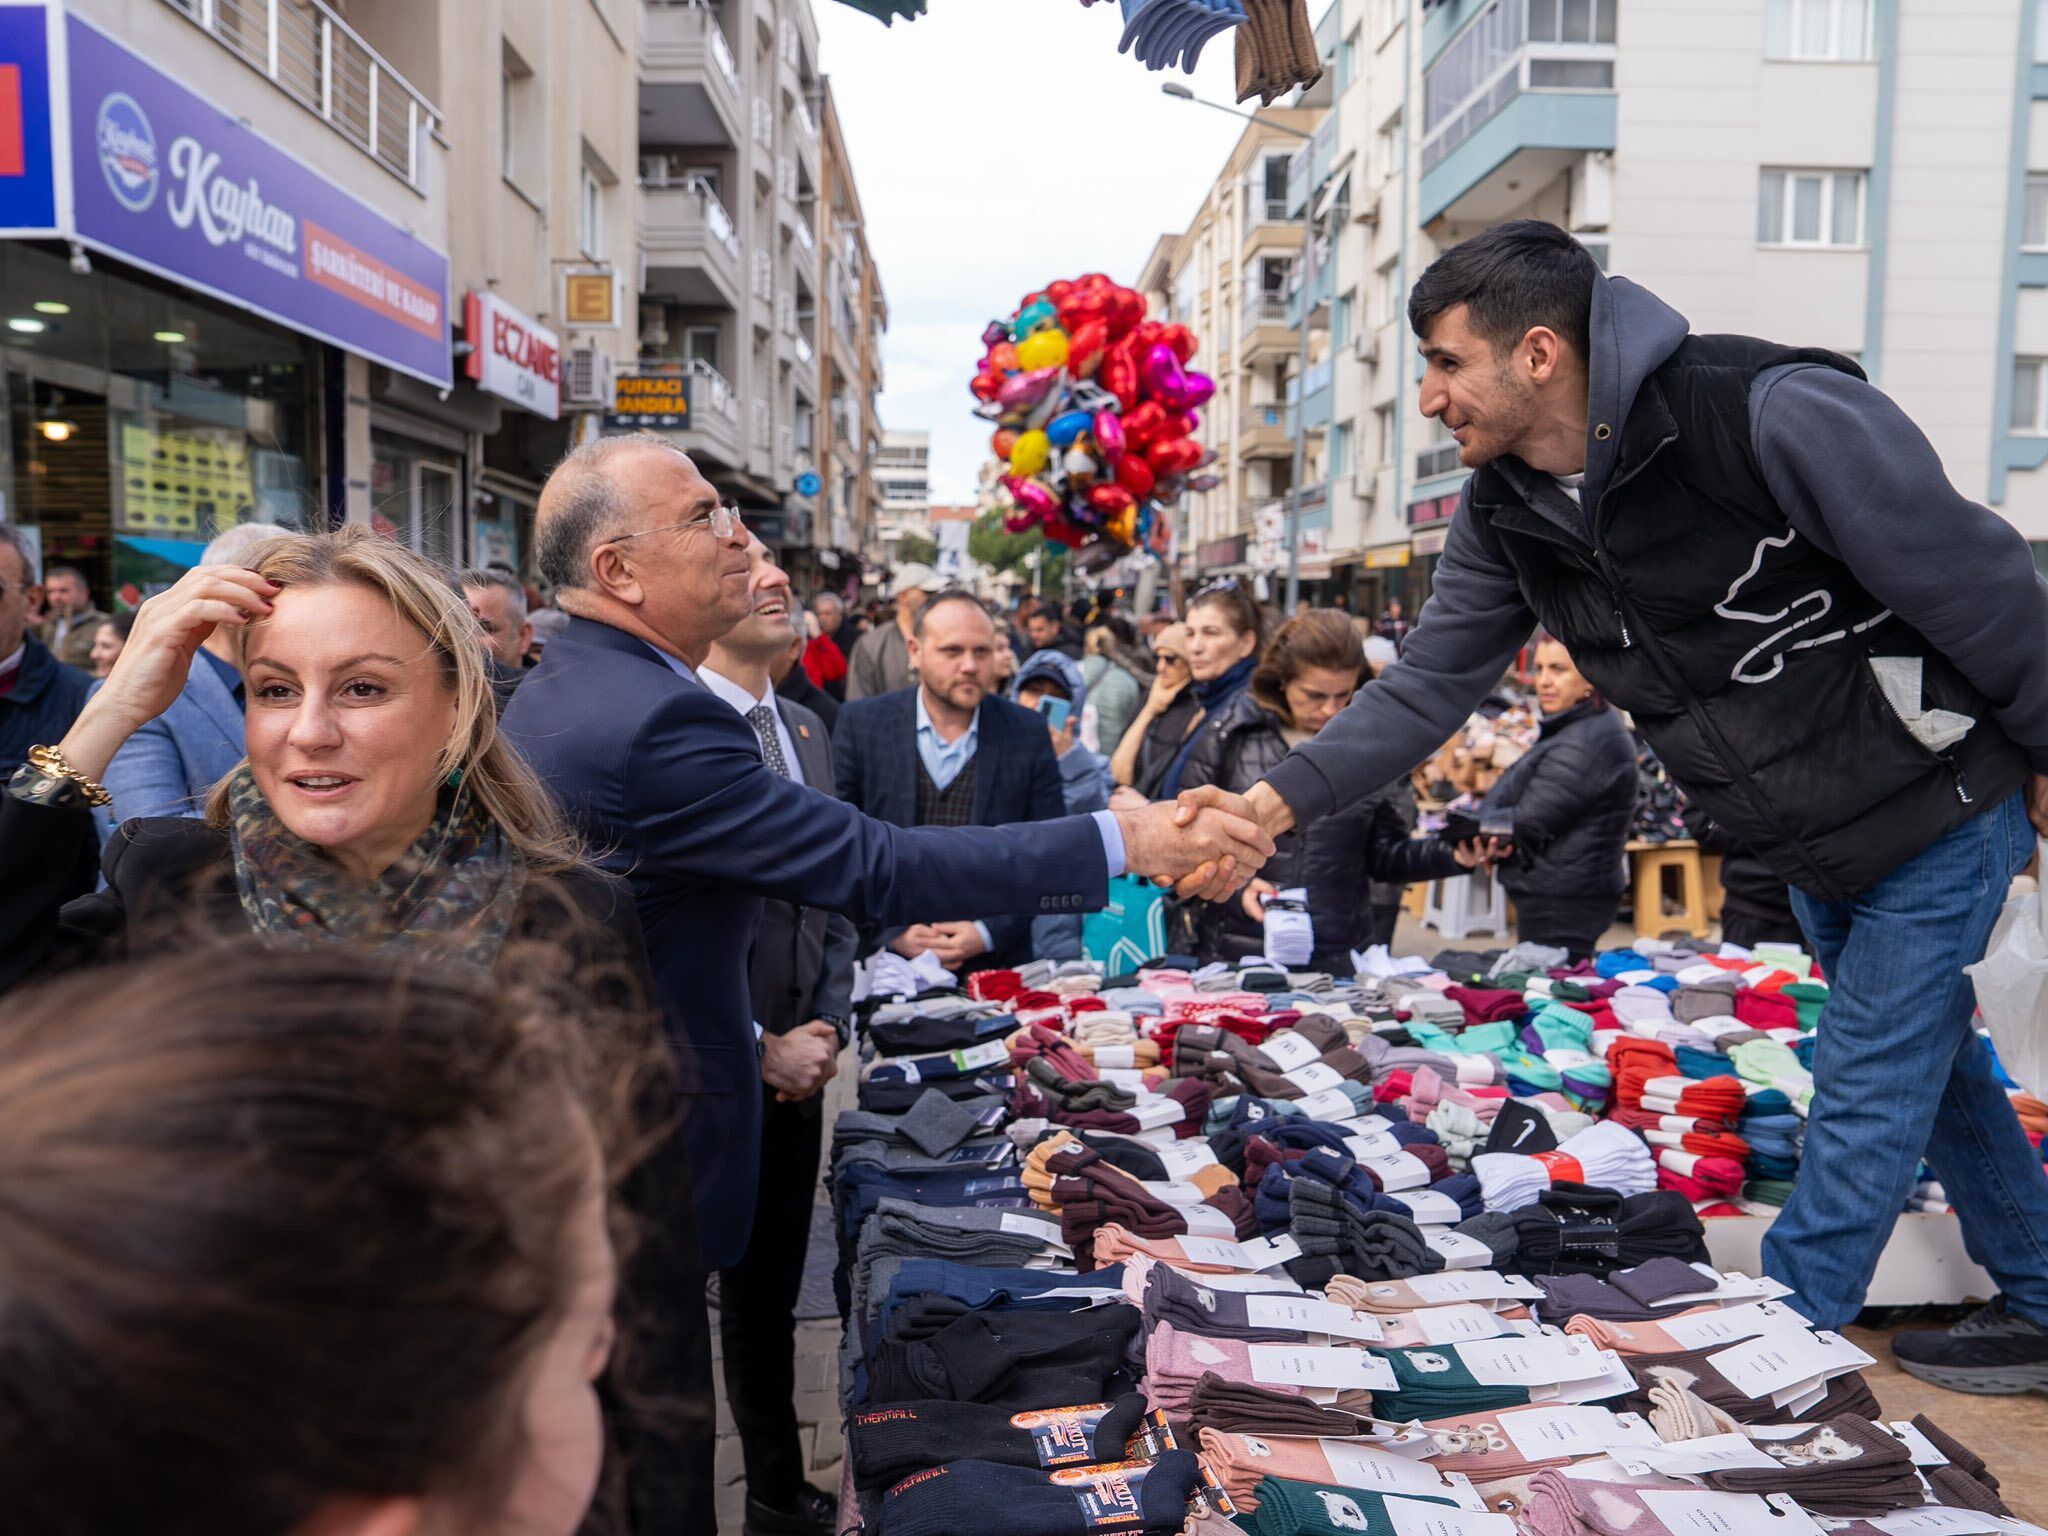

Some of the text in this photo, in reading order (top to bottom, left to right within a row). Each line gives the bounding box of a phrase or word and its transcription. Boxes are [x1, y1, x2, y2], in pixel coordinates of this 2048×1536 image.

[167, 136, 297, 254] Kayhan
[493, 308, 560, 384] ECZANE
[1502, 1353, 1518, 1373] COTTON
[1756, 1353, 1779, 1372] COTTON
[1549, 1421, 1566, 1441] COTTON
[1369, 1460, 1382, 1480] COTTON
[1696, 1508, 1720, 1533] COTTON
